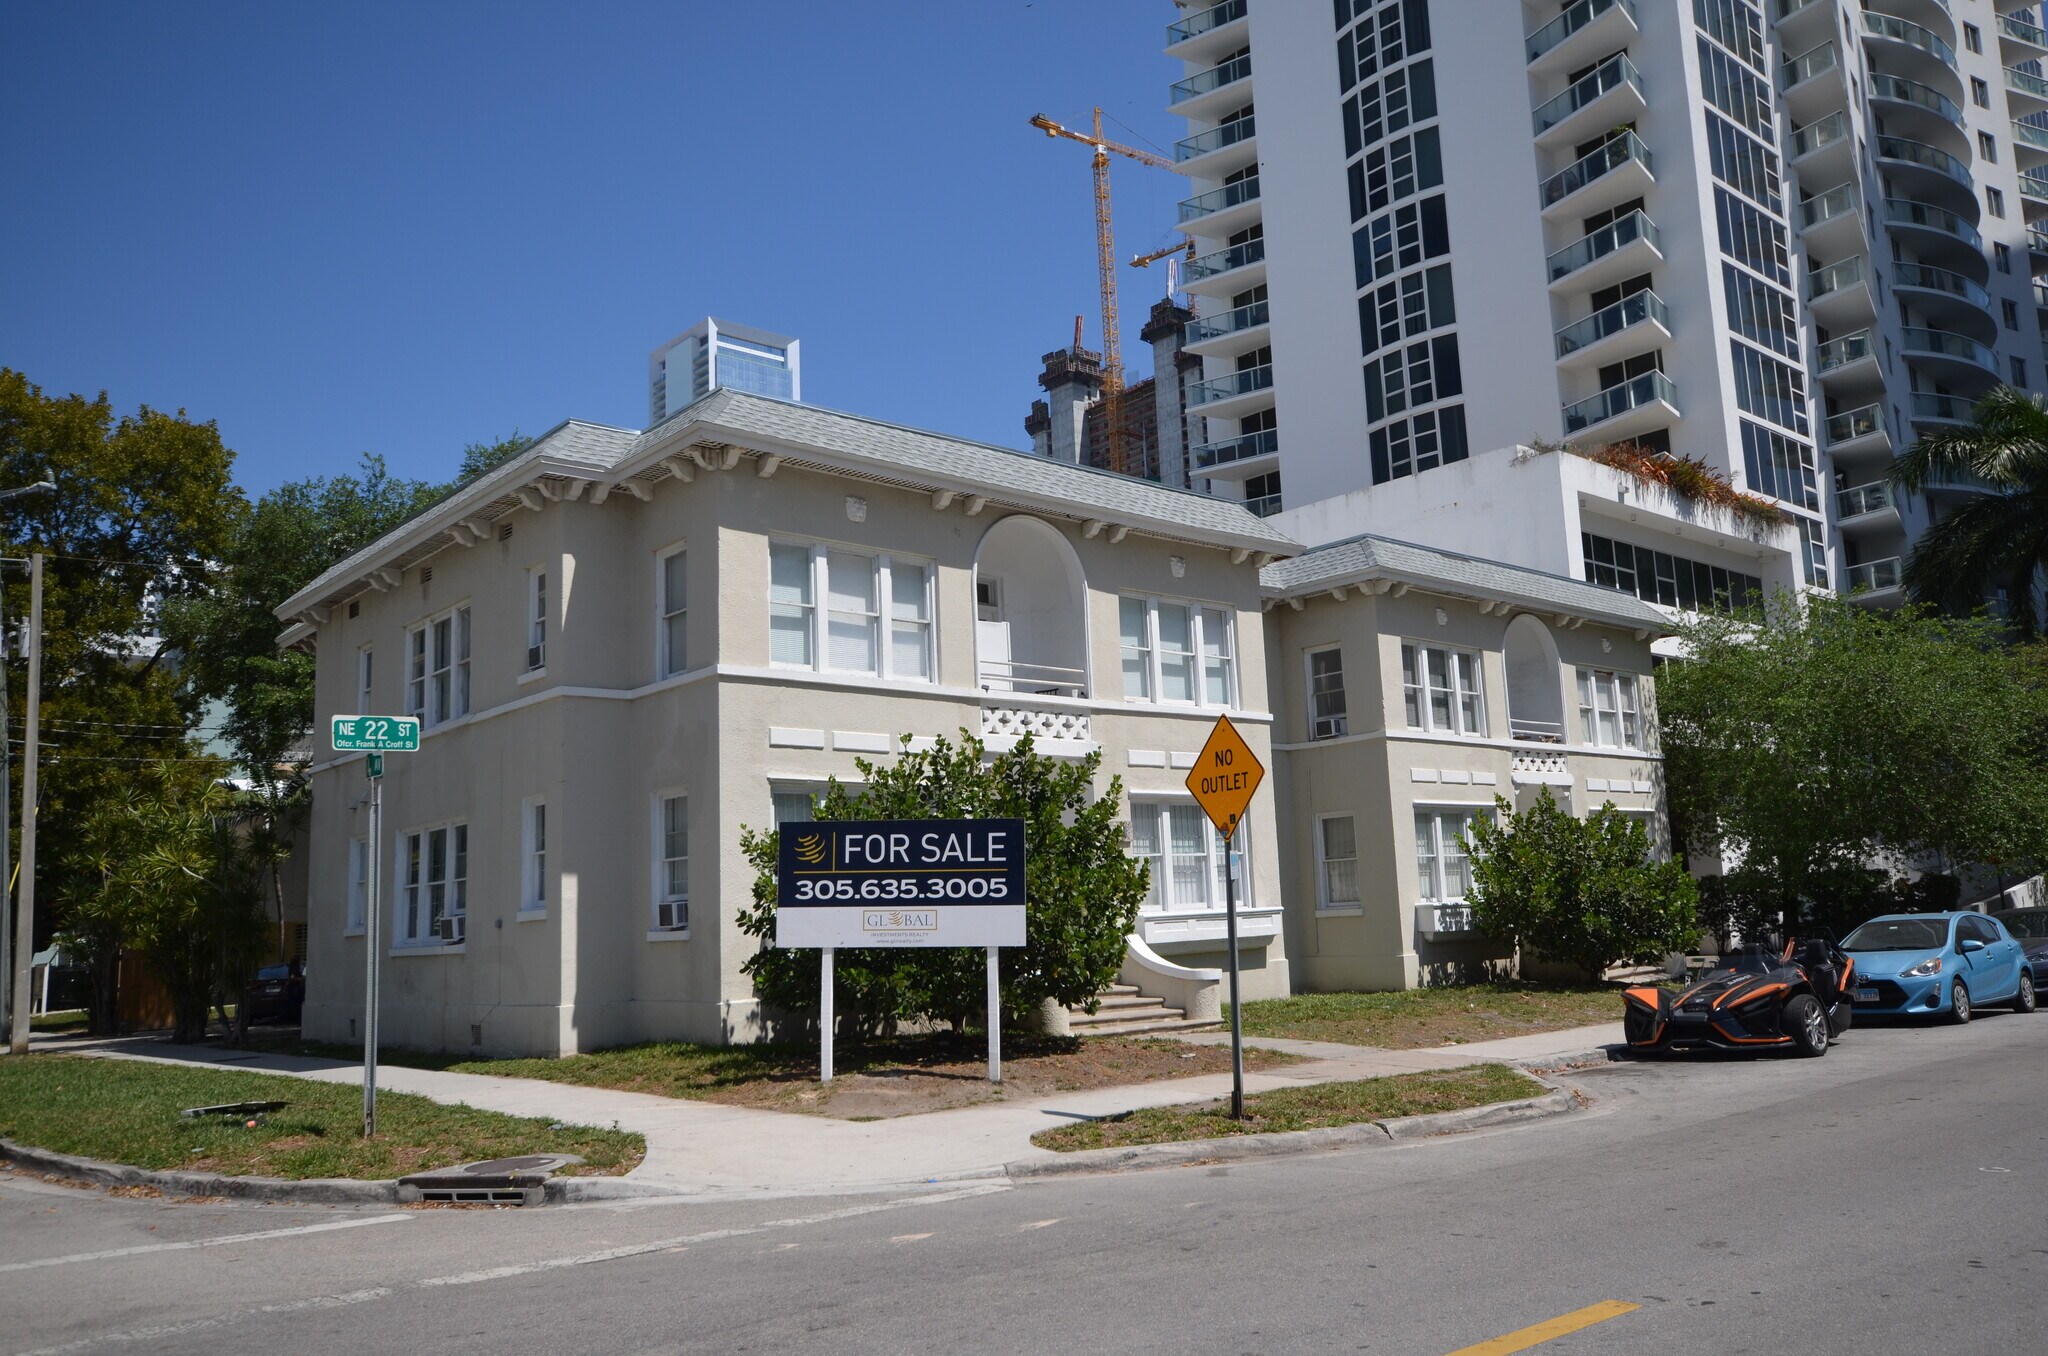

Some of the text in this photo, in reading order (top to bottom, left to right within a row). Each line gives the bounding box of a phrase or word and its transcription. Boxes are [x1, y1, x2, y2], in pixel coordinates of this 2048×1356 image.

[339, 720, 411, 739] NE 22 ST
[1215, 749, 1233, 767] NO
[1201, 772, 1248, 794] OUTLET
[844, 832, 1007, 864] FOR SALE
[794, 878, 1008, 900] 305.635.3005
